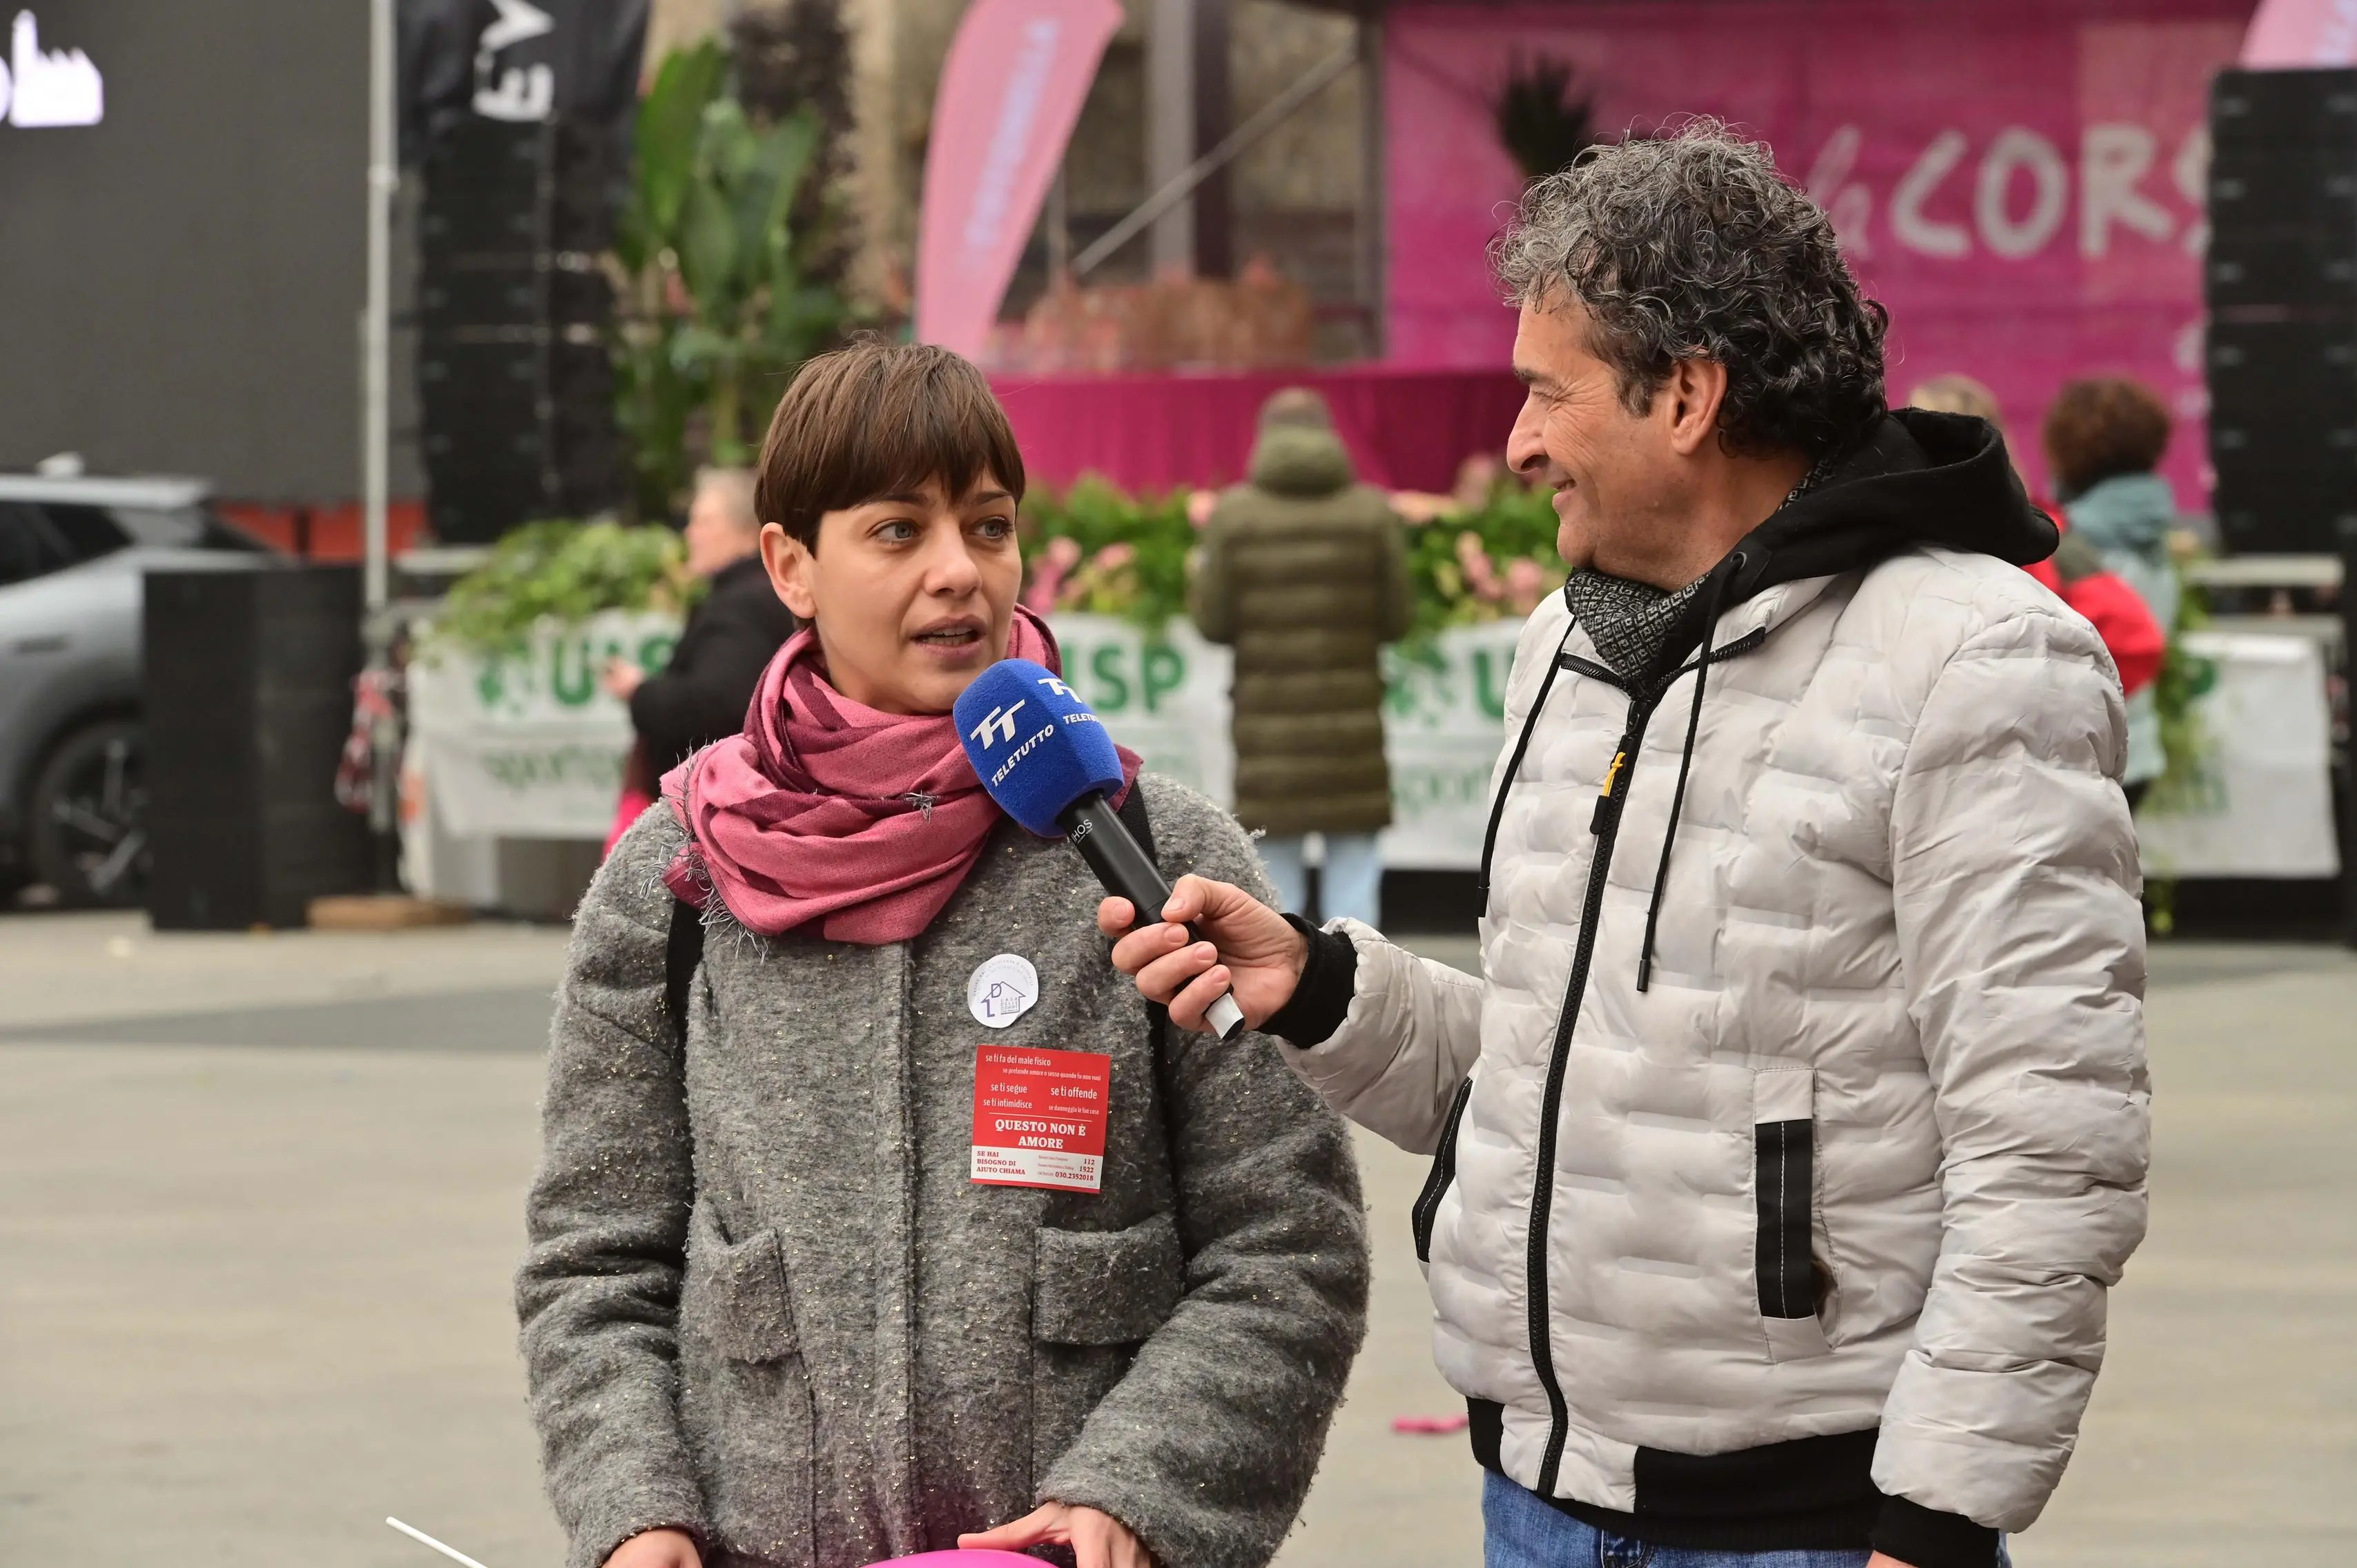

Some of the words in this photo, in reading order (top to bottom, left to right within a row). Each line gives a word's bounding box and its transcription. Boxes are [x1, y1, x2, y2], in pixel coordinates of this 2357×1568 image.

[991, 724, 1054, 787] TELETUTTO
[993, 1053, 999, 1063] ti
[999, 1054, 1006, 1063] fa
[1007, 1055, 1017, 1063] del
[1018, 1056, 1034, 1065] male
[1034, 1056, 1051, 1066] fisico
[991, 1083, 998, 1092] se
[1000, 1083, 1005, 1092] ti
[1006, 1084, 1027, 1094] segue
[1050, 1087, 1059, 1096] se
[1060, 1085, 1067, 1096] ti
[1068, 1087, 1098, 1099] offende
[991, 1097, 997, 1107] ti
[998, 1098, 1033, 1109] intimidisce
[1054, 1105, 1077, 1114] danneggia
[995, 1119, 1047, 1132] QUESTO
[1049, 1123, 1076, 1135] NON
[1078, 1123, 1086, 1136] È
[1018, 1136, 1063, 1149] AMORE
[1055, 1171, 1094, 1181] 030.2352018
